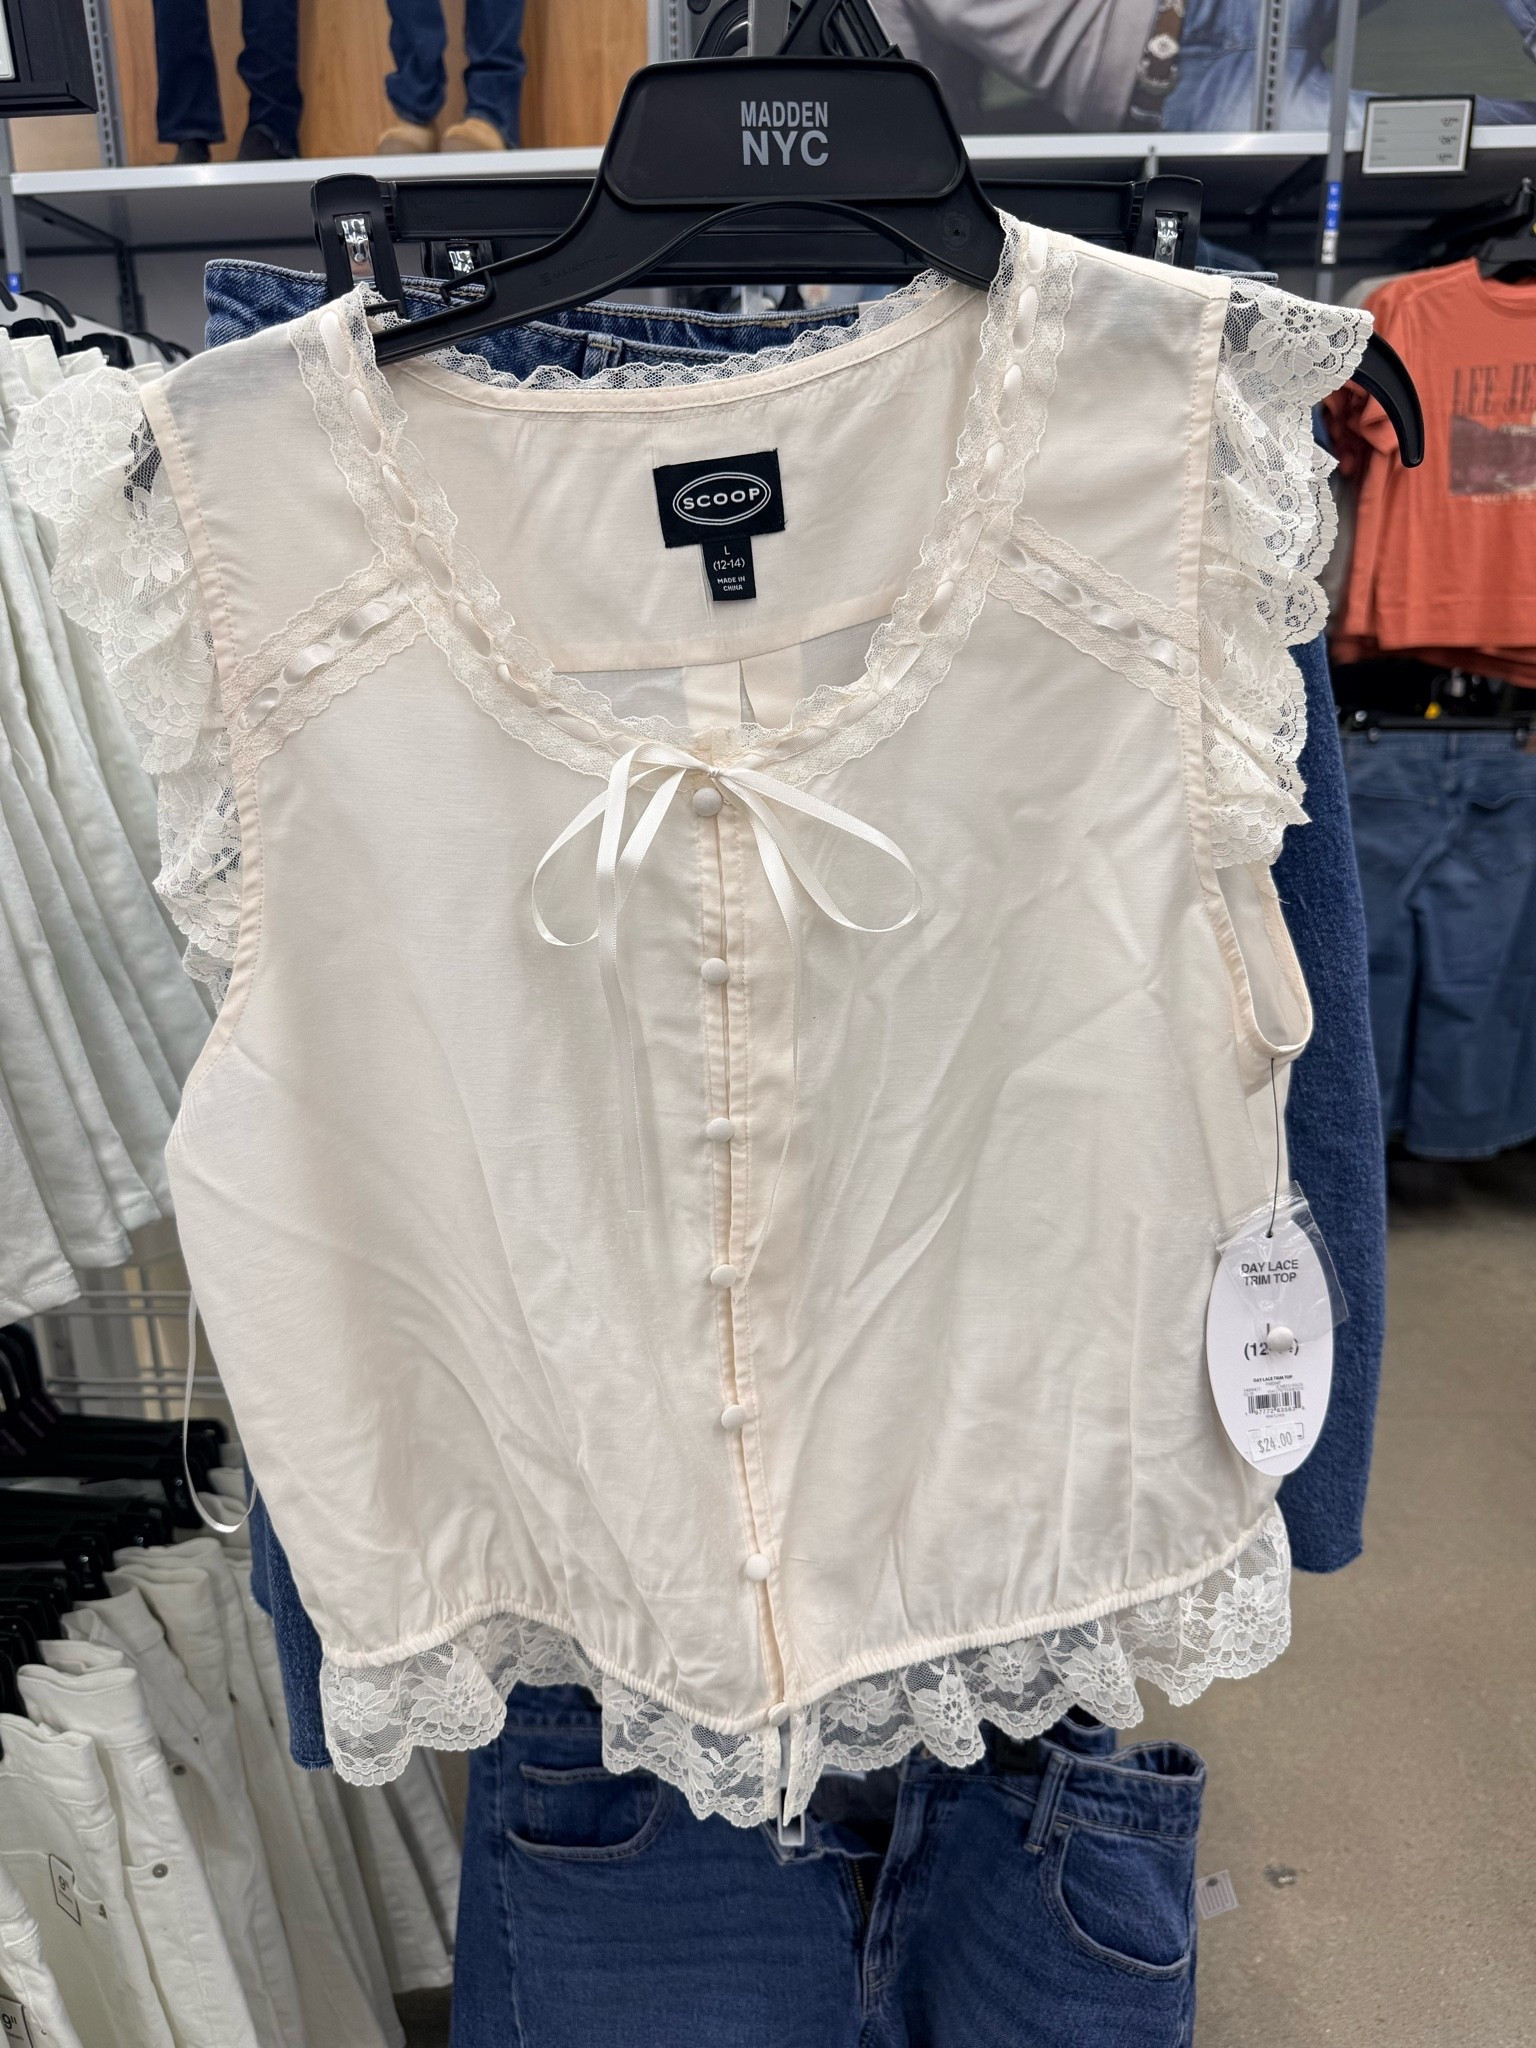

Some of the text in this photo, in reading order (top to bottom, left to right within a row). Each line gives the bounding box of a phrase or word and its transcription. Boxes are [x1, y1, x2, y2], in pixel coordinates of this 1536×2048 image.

[740, 101, 829, 128] MADDEN
[742, 130, 829, 166] NYC
[682, 487, 761, 511] SCOOP
[724, 545, 731, 555] L
[713, 557, 746, 572] (12-14)
[723, 584, 744, 592] CHINA
[1241, 1259, 1299, 1274] DAY LACE
[1243, 1272, 1297, 1286] TRIM TOP
[1244, 1338, 1299, 1361] (12)
[1257, 1431, 1293, 1454] $24.00
